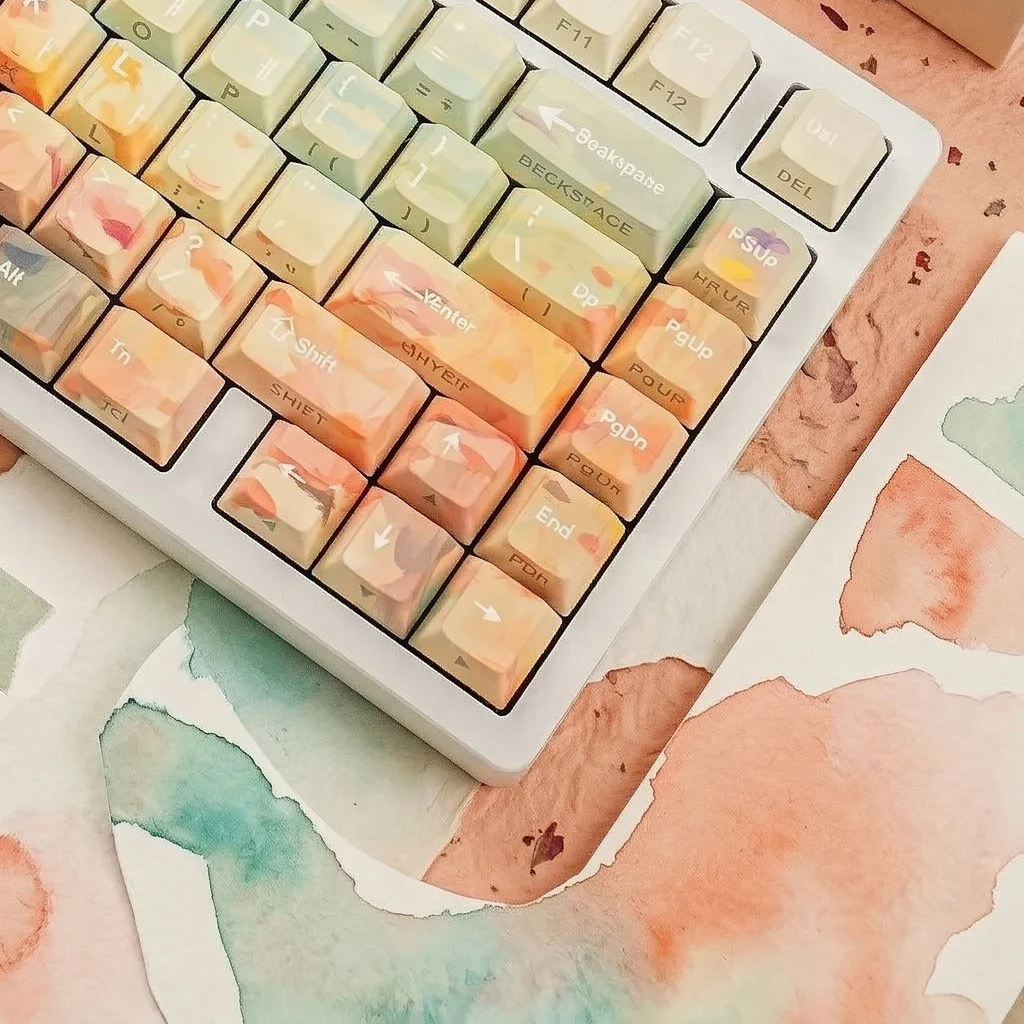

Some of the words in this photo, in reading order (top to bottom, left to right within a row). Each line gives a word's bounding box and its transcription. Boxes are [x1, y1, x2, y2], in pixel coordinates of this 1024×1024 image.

[132, 21, 152, 40] O
[246, 8, 271, 29] P
[555, 18, 593, 50] F11
[111, 51, 129, 78] L
[221, 83, 240, 99] P
[649, 79, 687, 111] F12
[88, 123, 101, 144] L
[408, 163, 428, 188] ]
[777, 169, 815, 201] DEL
[665, 318, 713, 359] PgUp
[294, 336, 338, 374] Shift
[598, 409, 649, 452] PgDn
[535, 504, 576, 540] End
